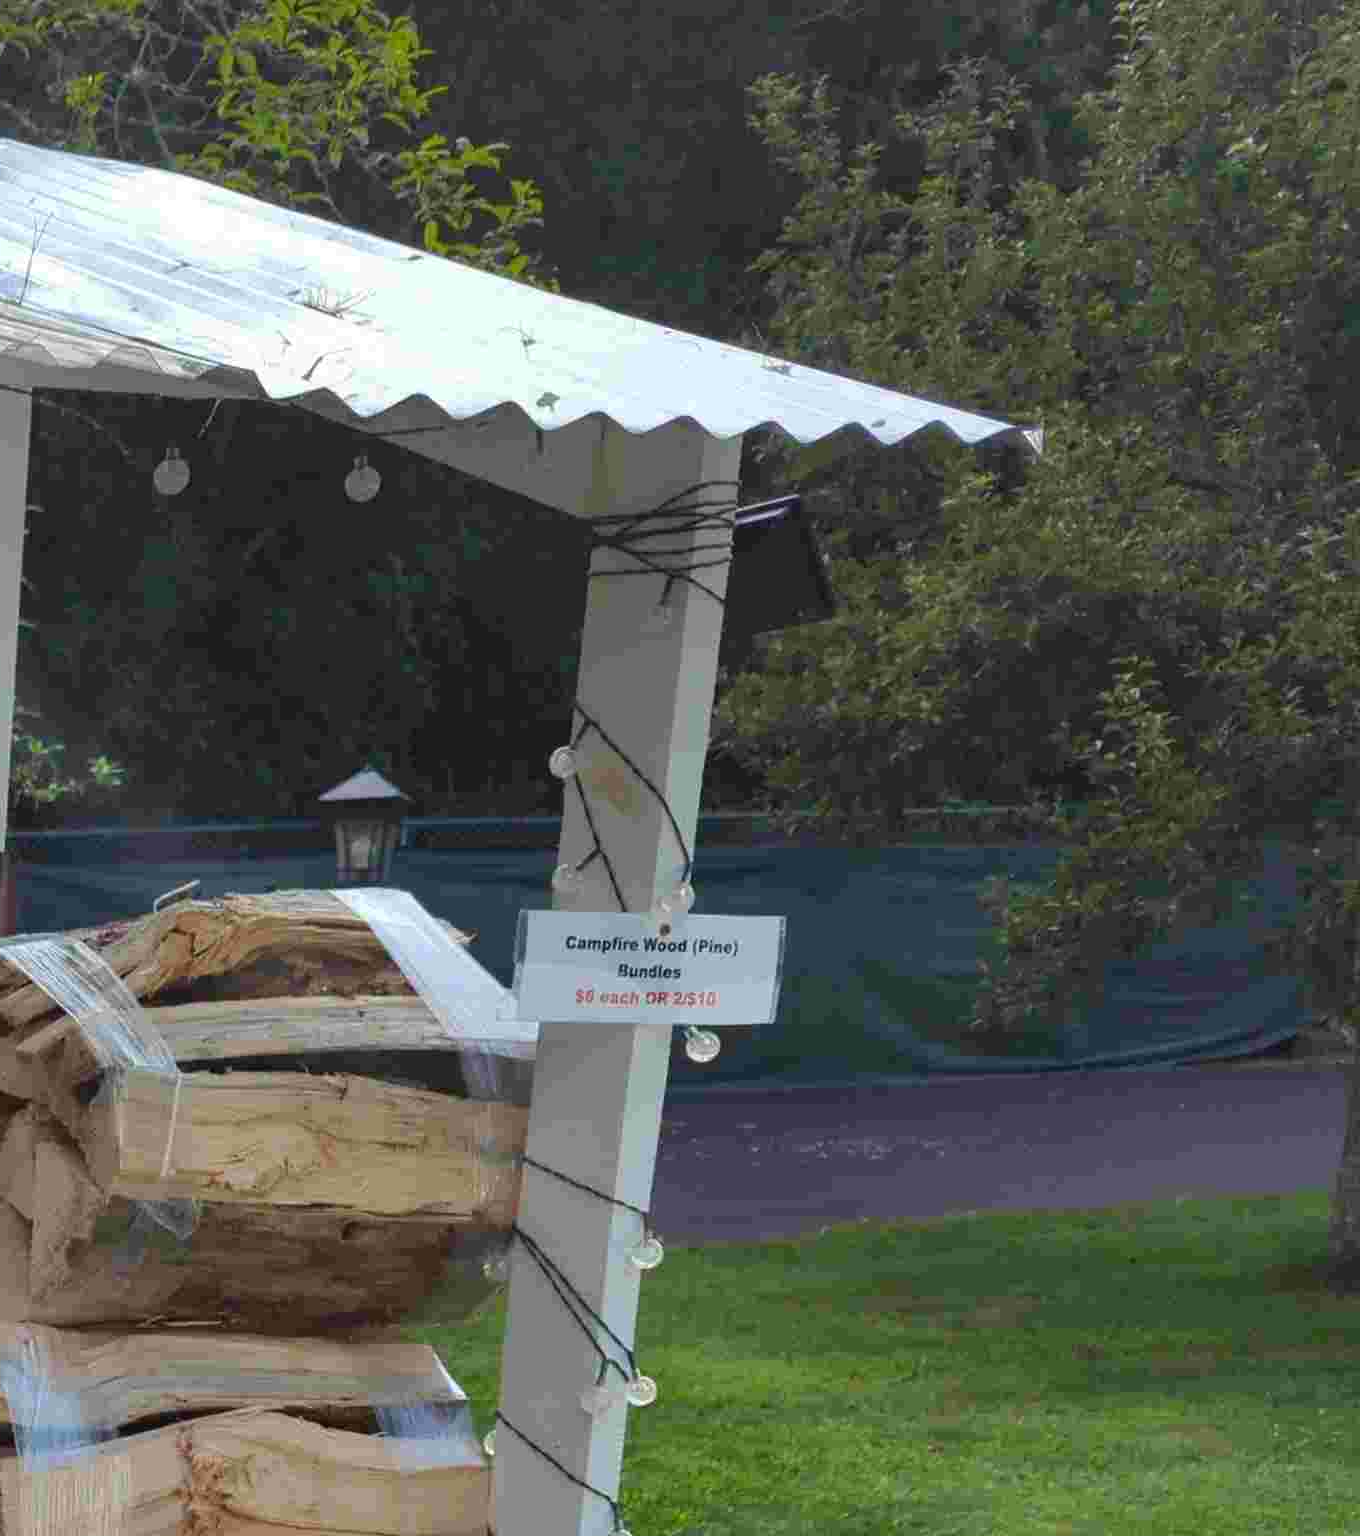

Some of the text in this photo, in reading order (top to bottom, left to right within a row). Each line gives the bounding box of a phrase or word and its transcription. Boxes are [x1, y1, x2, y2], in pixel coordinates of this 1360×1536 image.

[565, 935, 639, 953] Campfire
[643, 937, 687, 953] Wood
[617, 963, 681, 979] Bundles
